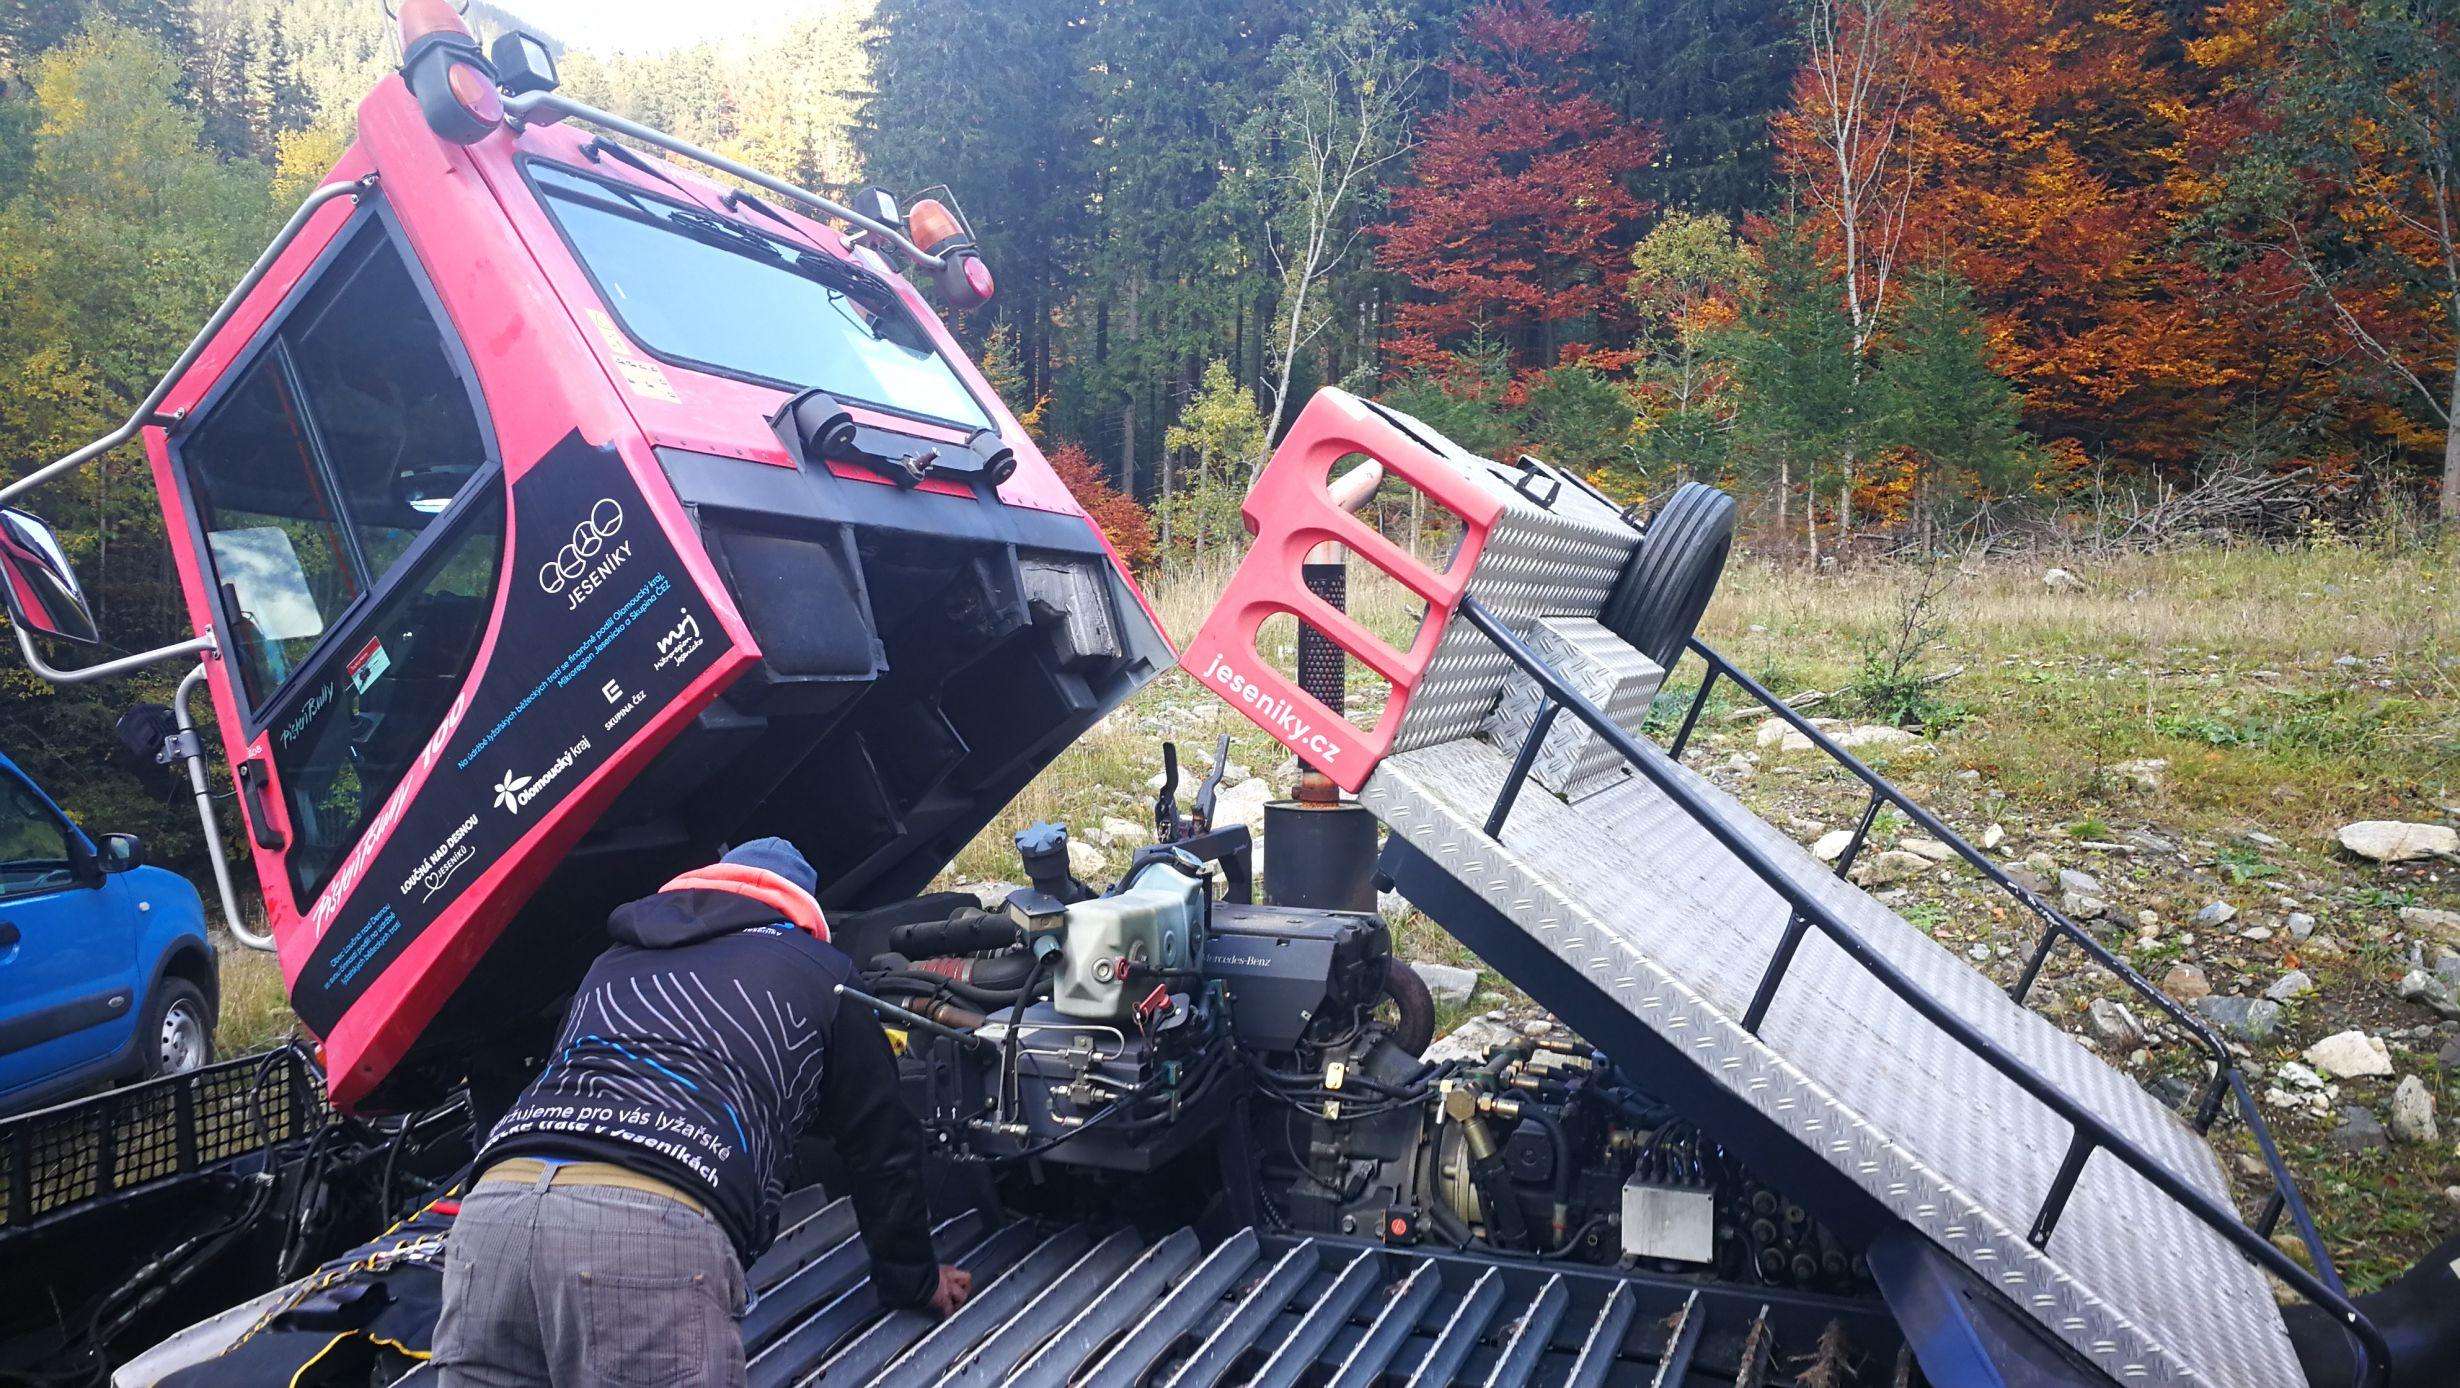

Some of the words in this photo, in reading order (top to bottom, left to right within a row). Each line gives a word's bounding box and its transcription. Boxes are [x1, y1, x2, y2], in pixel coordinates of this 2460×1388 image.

[567, 540, 633, 611] JESENÍKY
[557, 652, 595, 688] Mikroregion
[594, 624, 626, 655] Jesenicko
[629, 595, 657, 620] Skupina
[655, 579, 671, 596] ČEZ
[458, 758, 468, 770] Na
[468, 738, 488, 760] údržbě
[486, 711, 517, 741] lyžařských
[515, 681, 549, 713] běžeckých
[560, 661, 569, 671] se
[568, 635, 597, 663] finančně
[613, 585, 650, 620] Olomoucký
[604, 702, 635, 731] SKUPINA
[632, 690, 648, 705] ČEZ
[1203, 652, 1342, 764] jeseniky.cz
[421, 691, 466, 770] 100
[517, 750, 574, 806] Olomoucký
[569, 735, 592, 758] kraj
[400, 860, 434, 895] LOUČNÁ
[430, 844, 449, 868] NAD
[446, 813, 479, 847] DESNOU
[576, 1106, 613, 1121] pro
[619, 1106, 650, 1125] vás
[654, 1111, 732, 1162] lyžařské
